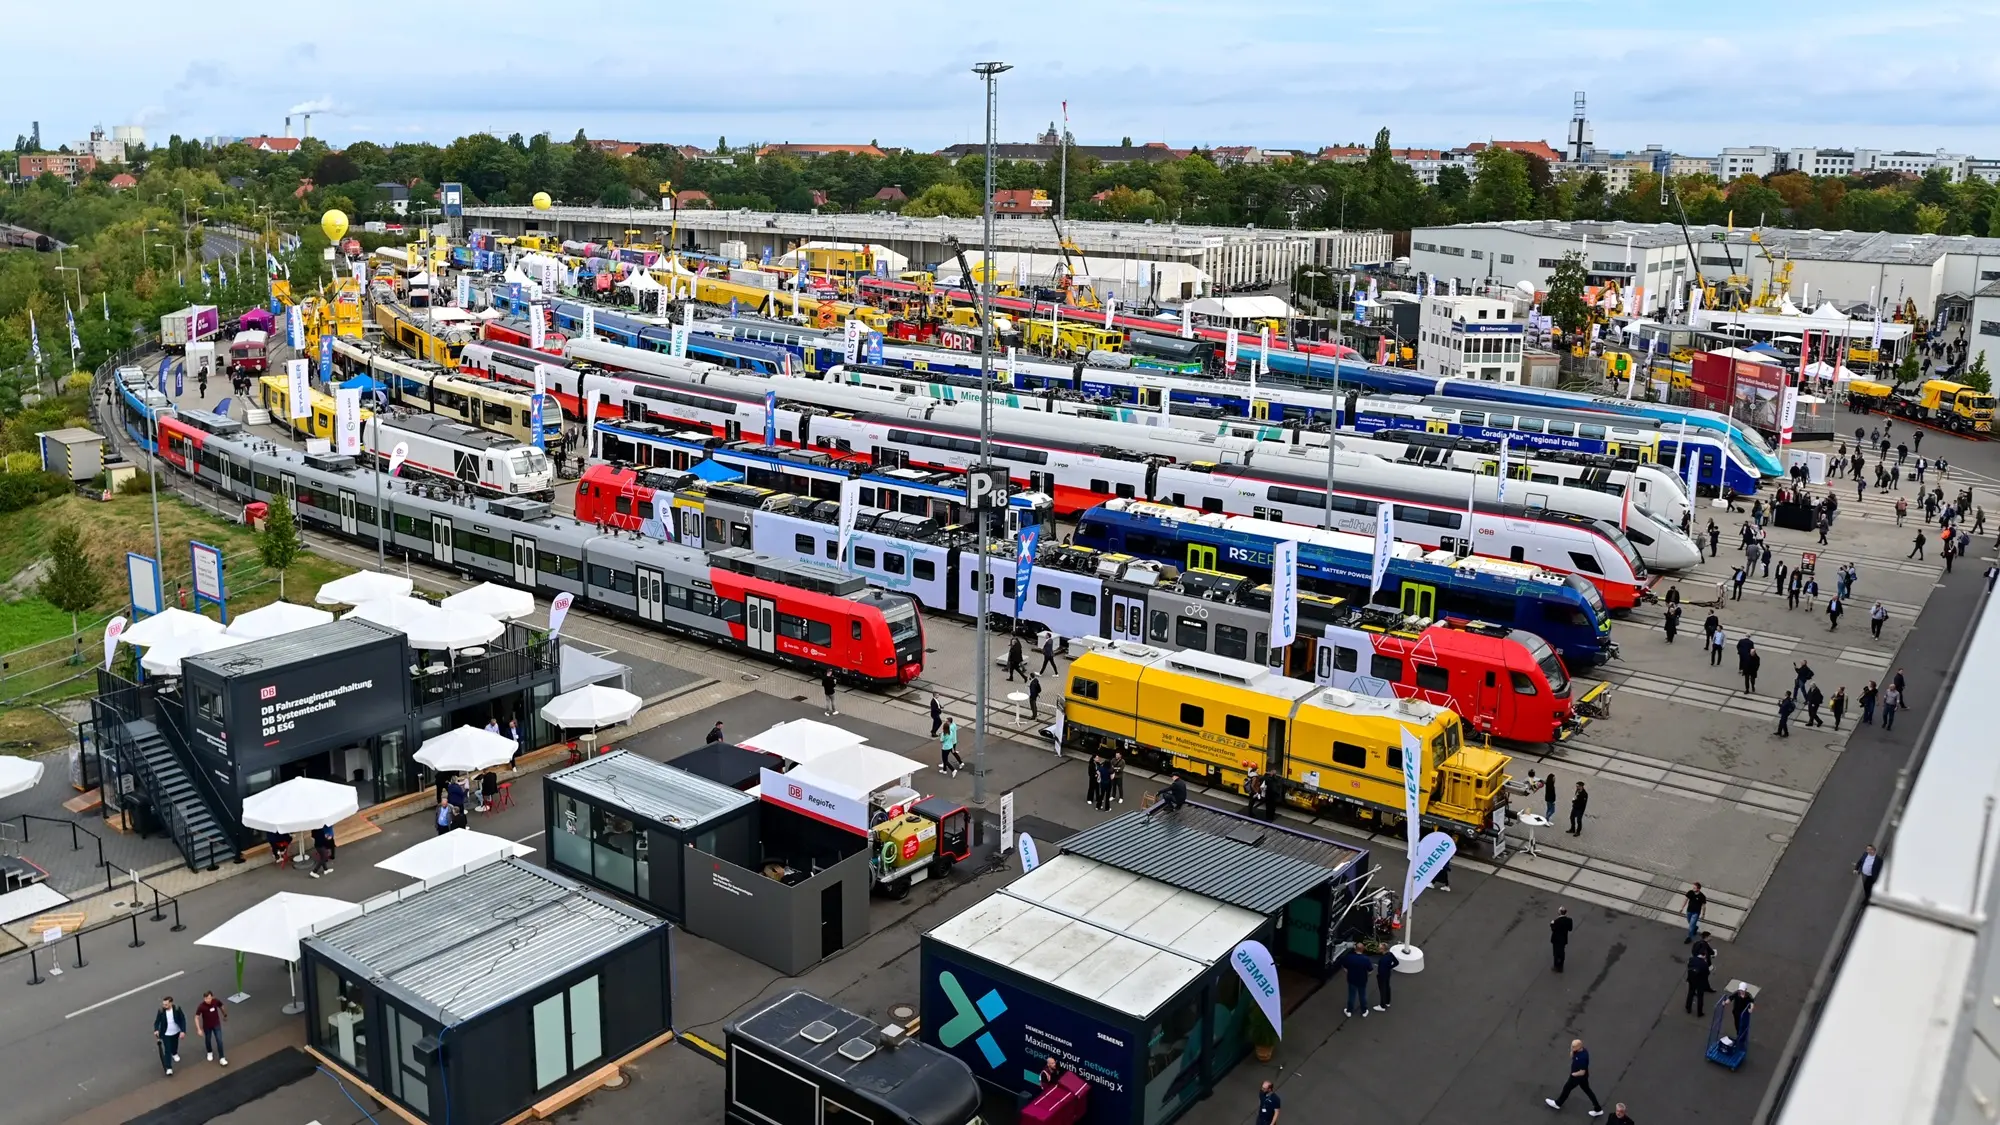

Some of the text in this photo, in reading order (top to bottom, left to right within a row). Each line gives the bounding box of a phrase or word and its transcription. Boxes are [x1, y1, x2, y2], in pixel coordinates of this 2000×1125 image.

[674, 330, 684, 357] EMENS
[846, 322, 856, 362] ALSTOM
[296, 364, 304, 414] STADLER
[1481, 429, 1507, 439] Coradia
[1531, 436, 1560, 445] regional
[1561, 439, 1579, 447] train
[970, 472, 992, 509] P
[988, 490, 1008, 508] 18
[1478, 528, 1495, 536] ÖBB
[1229, 547, 1275, 564] RSZER
[1322, 566, 1372, 580] BATTERY POWERE
[1104, 588, 1109, 596] 2
[556, 598, 568, 610] DB
[110, 624, 121, 636] DB
[802, 618, 808, 627] 2
[261, 679, 372, 715] DB Fahrzeuginstandhaltung
[262, 687, 276, 699] DB
[262, 699, 336, 726] DB Systemtechnik
[263, 722, 294, 736] DB ESG
[1176, 736, 1236, 757] Multisensorplattform
[790, 785, 836, 811] DB RegioTec
[1414, 840, 1450, 882] SIEMENS
[1025, 1024, 1072, 1047] SIEMENS XCELERATOR
[1097, 1032, 1124, 1048] SIEMENS
[1025, 1034, 1119, 1079] Maximize your network
[1060, 1060, 1076, 1074] with
[1078, 1068, 1114, 1092] Signaling
